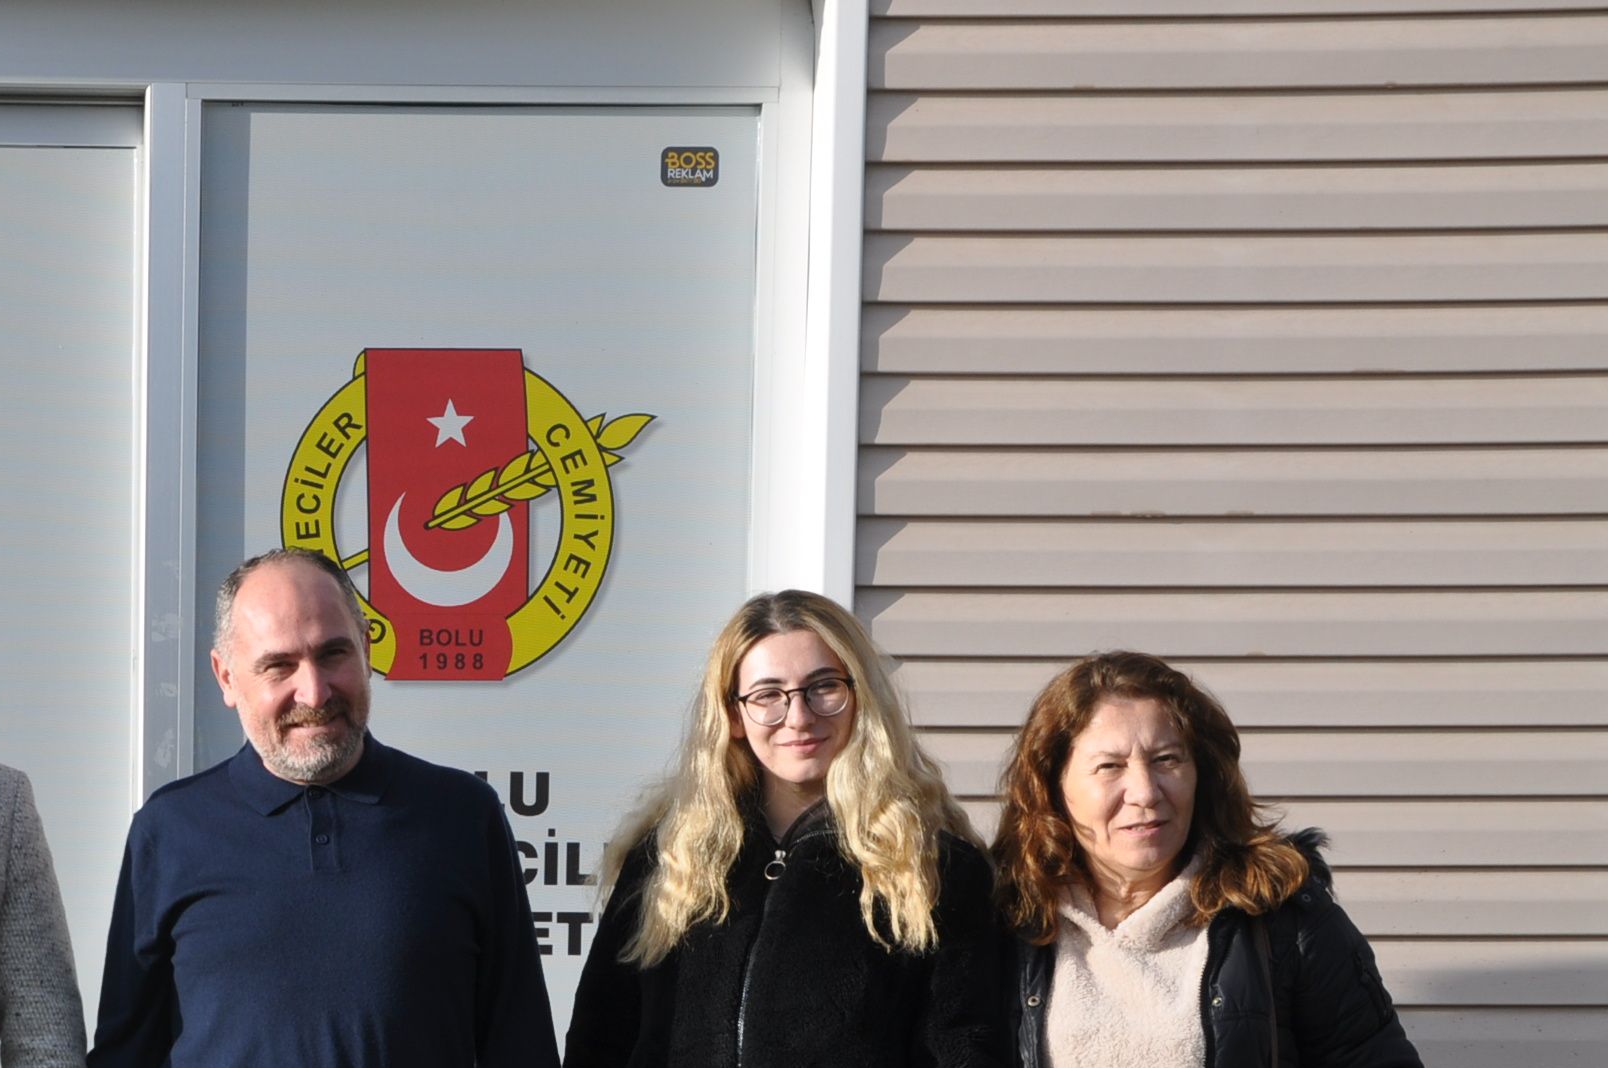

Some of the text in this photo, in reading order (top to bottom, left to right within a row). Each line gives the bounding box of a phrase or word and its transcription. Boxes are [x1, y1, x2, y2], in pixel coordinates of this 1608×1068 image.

[665, 152, 715, 169] BOSS
[667, 168, 714, 180] REKLAM
[542, 423, 605, 620] CEMİYETİ
[419, 628, 484, 647] BOLU
[419, 652, 484, 670] 1988
